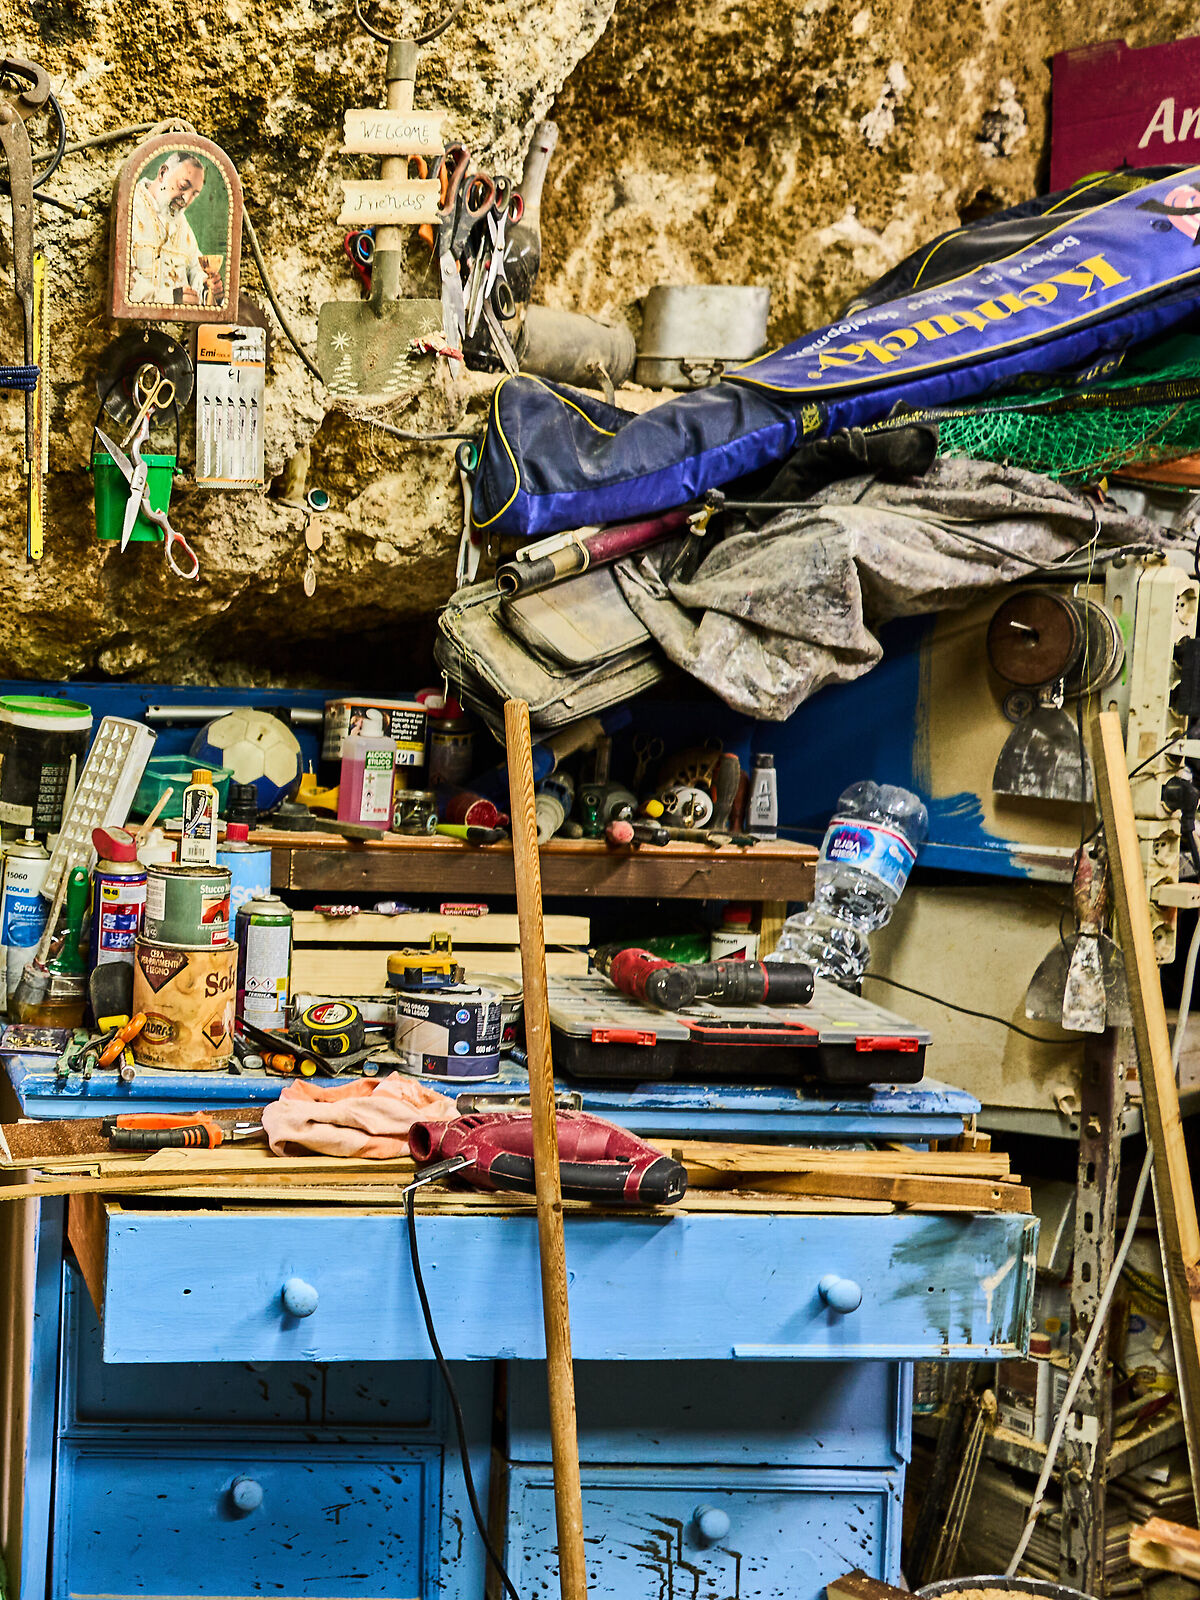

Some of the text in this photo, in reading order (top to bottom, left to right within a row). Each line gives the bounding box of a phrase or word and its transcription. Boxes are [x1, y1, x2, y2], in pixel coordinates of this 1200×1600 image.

[360, 121, 429, 145] WELCOME
[354, 194, 426, 211] Friends
[818, 253, 1132, 372] Kentucky
[200, 348, 217, 357] Emi
[367, 751, 392, 759] ALCOOL
[833, 838, 860, 857] Vera
[103, 888, 118, 896] WD-40
[200, 883, 224, 894] Stucco
[13, 901, 37, 913] Spray
[150, 949, 164, 959] CERA
[149, 966, 170, 976] LEGNO
